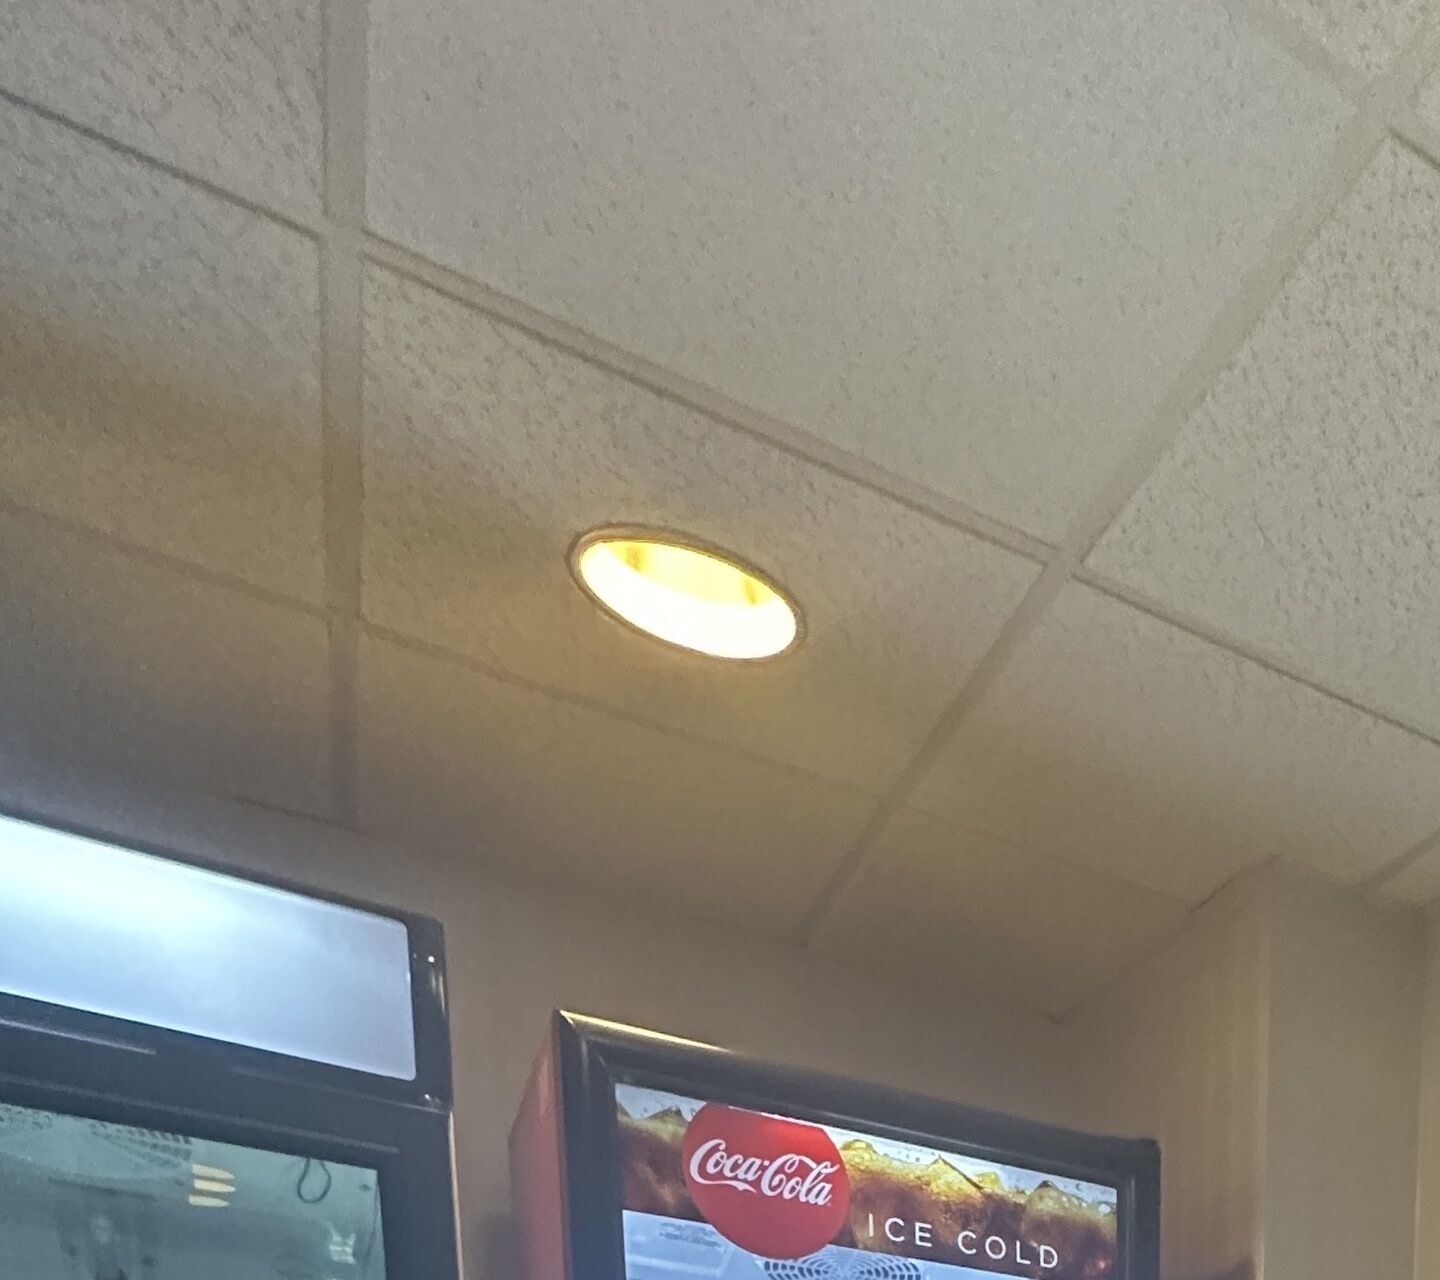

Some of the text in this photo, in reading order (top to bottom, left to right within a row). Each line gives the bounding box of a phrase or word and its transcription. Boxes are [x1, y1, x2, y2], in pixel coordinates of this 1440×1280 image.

[689, 1138, 841, 1208] Coca-Cola
[867, 1213, 1060, 1270] ICE COLD
